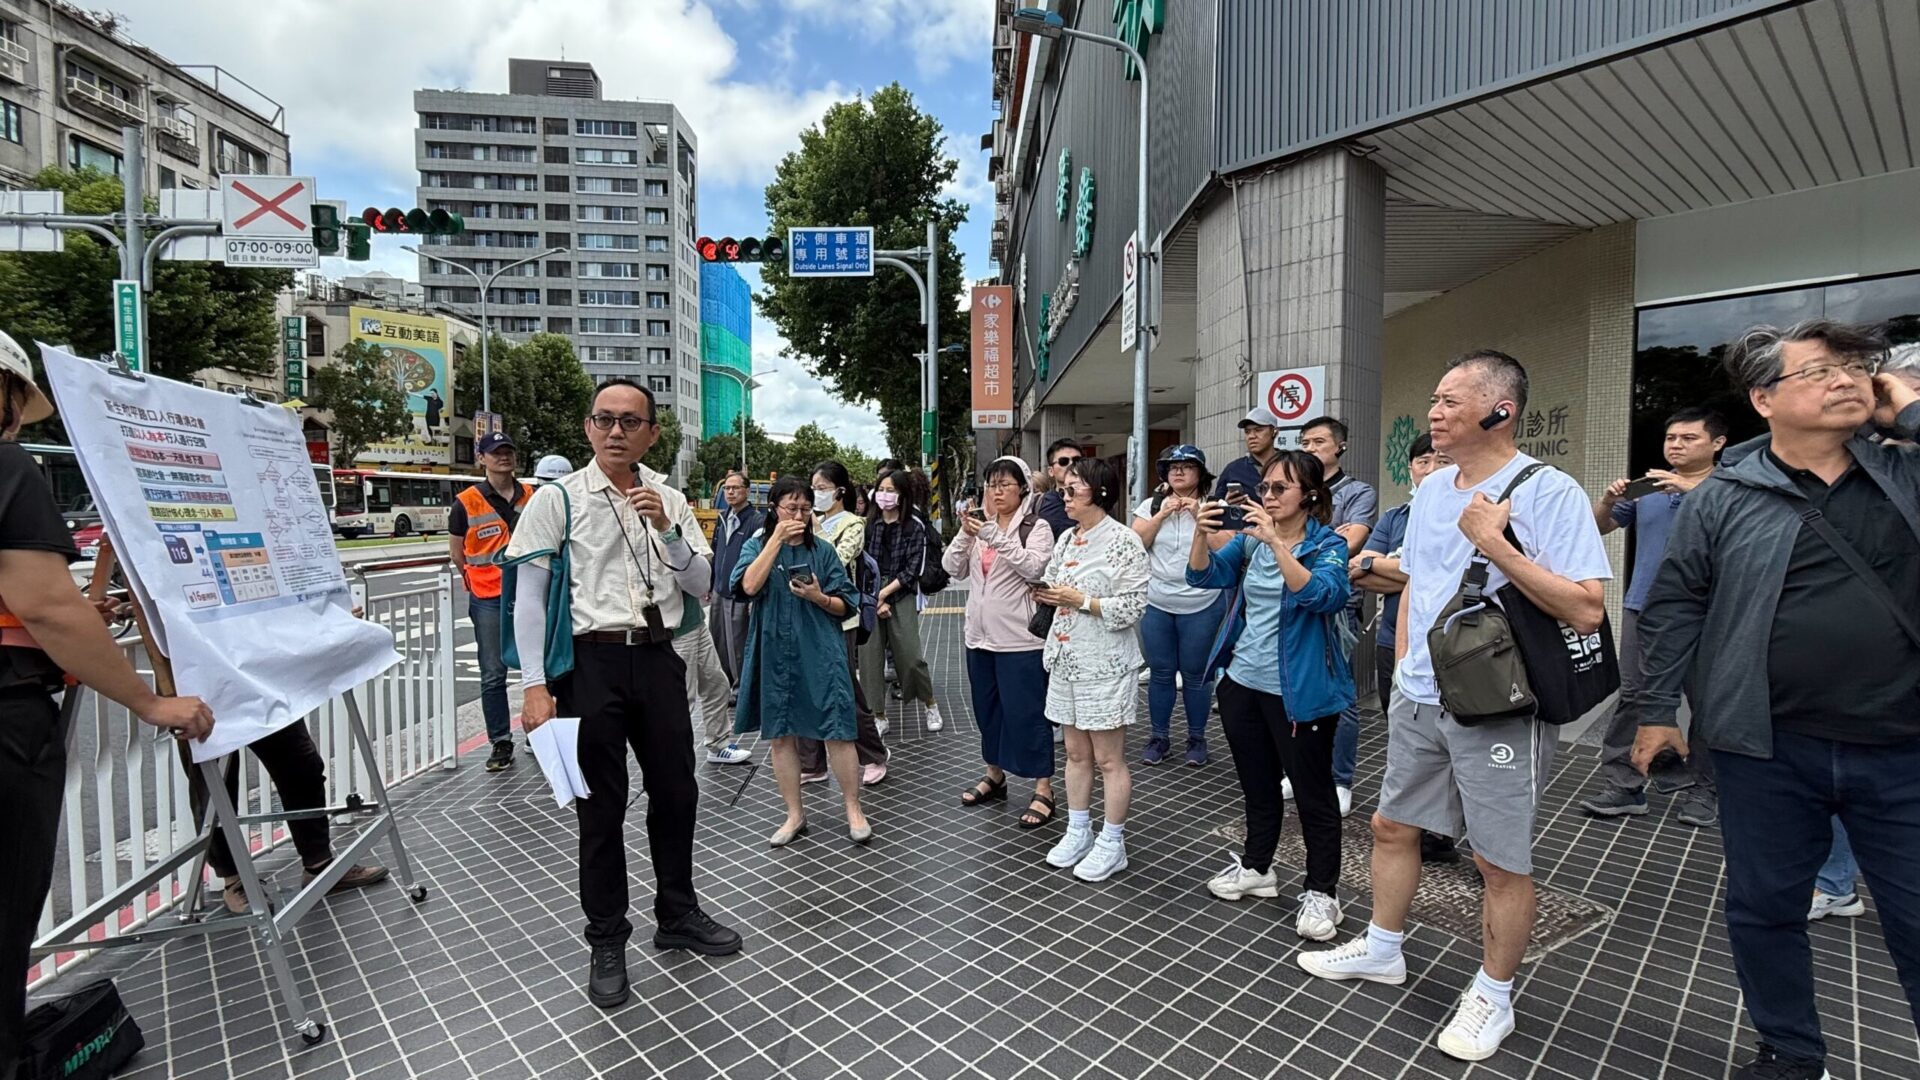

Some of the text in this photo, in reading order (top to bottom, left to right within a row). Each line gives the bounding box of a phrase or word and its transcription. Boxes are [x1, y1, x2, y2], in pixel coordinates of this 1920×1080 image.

[794, 232, 868, 245] 外側車道
[228, 241, 313, 255] 07:00-09:00
[795, 247, 869, 261] 專用號誌
[836, 263, 854, 272] Signal
[123, 297, 134, 351] 新生南路三段
[383, 325, 440, 344] 互動美語
[983, 313, 1000, 396] 家樂福超市
[1278, 384, 1300, 409] 停
[171, 547, 188, 560] 116
